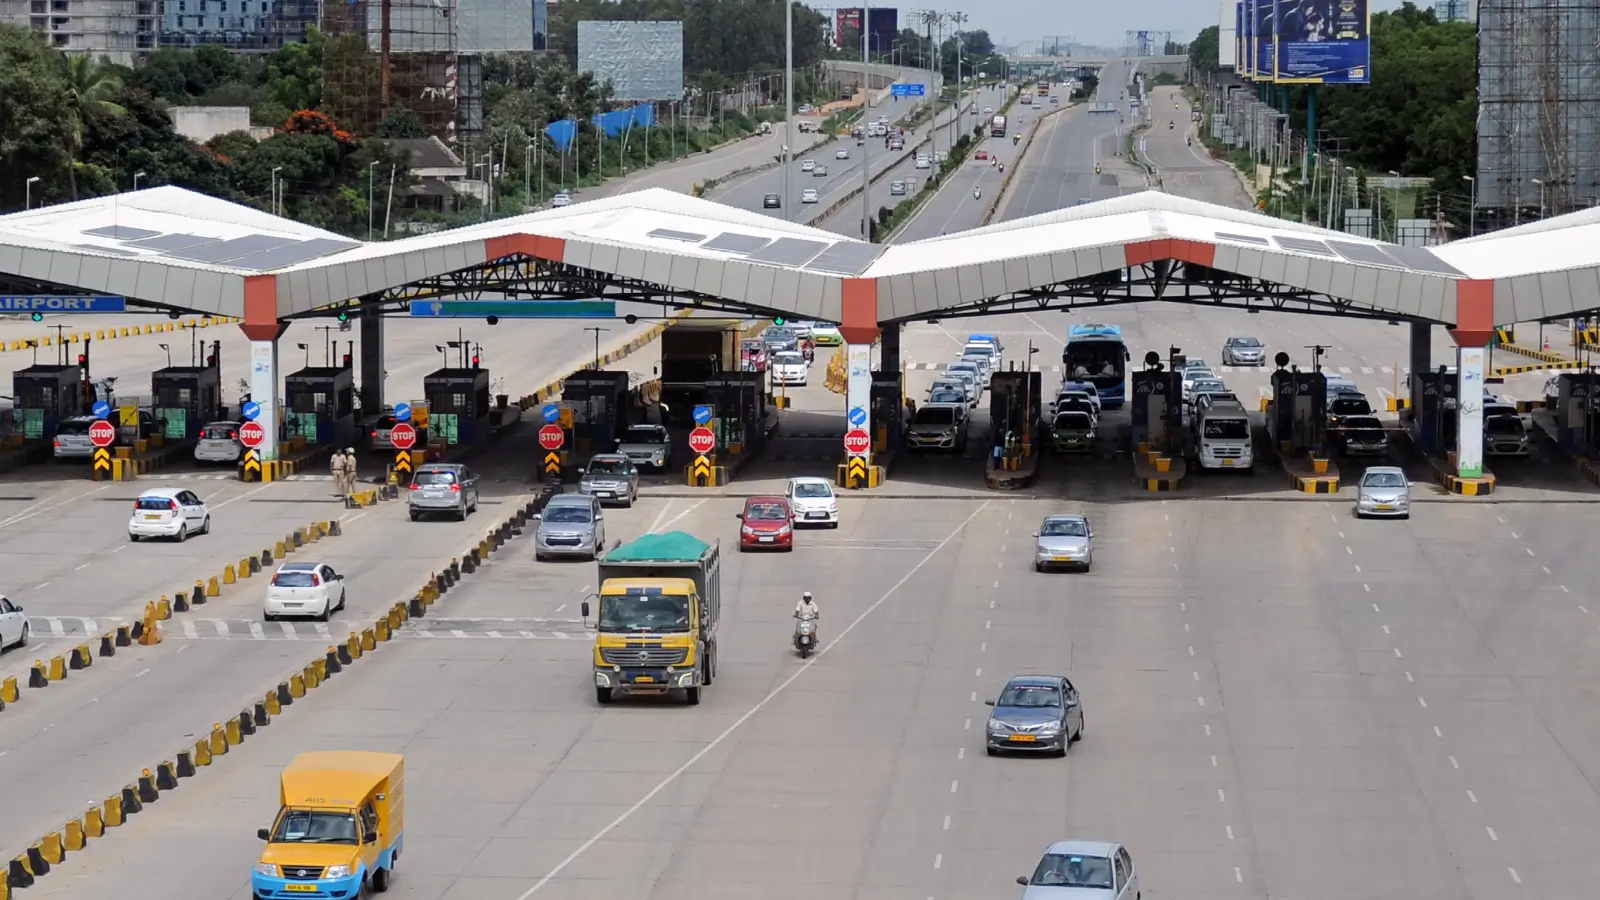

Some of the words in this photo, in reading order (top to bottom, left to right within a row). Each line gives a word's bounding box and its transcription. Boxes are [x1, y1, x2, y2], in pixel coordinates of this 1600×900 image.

[91, 429, 112, 437] STOP
[241, 430, 262, 438] STOP
[393, 431, 414, 440] STOP
[541, 433, 562, 441] STOP
[691, 436, 712, 444] STOP
[847, 437, 868, 445] STOP
